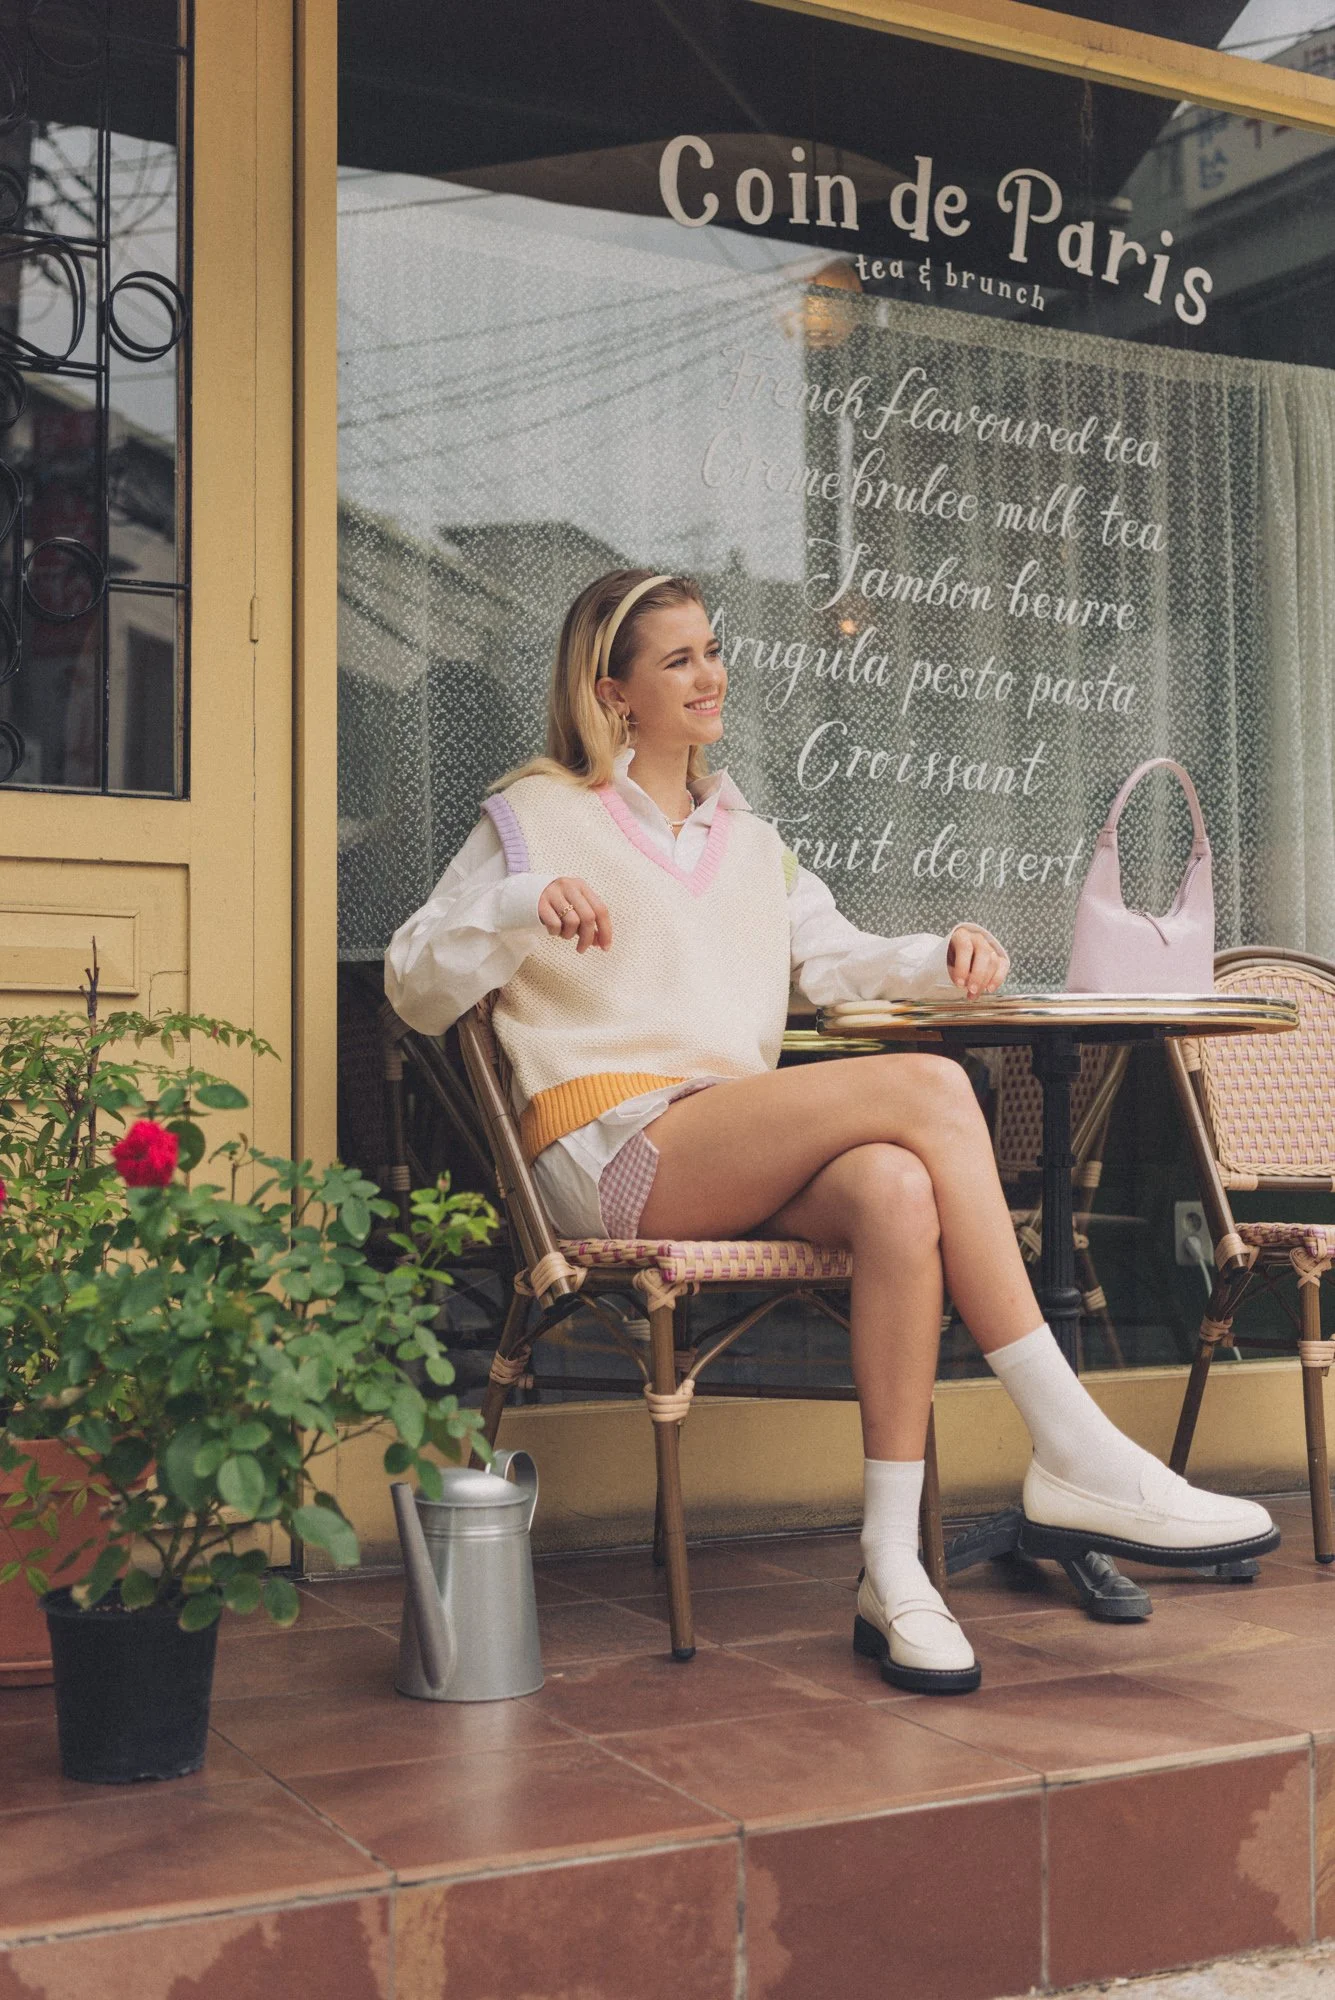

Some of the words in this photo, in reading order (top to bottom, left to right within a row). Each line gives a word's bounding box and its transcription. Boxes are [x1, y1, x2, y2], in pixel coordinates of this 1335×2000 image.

[659, 134, 860, 231] Coin
[889, 155, 971, 243] de
[996, 167, 1214, 326] Paris
[855, 254, 905, 282] tea
[918, 257, 932, 292] &
[945, 261, 1046, 312] brunch
[718, 345, 872, 420] French
[862, 365, 1099, 455] flavoured
[1102, 421, 1162, 469] tea
[850, 447, 979, 522] brulee
[996, 482, 1088, 540] milk
[1100, 494, 1168, 551] tea
[804, 536, 996, 612] Jambon
[1005, 559, 1138, 632] beurre
[900, 651, 1016, 716] pesto
[1025, 664, 1139, 720] pasta
[796, 720, 1047, 796] Croissant
[912, 823, 1084, 888] dessert
